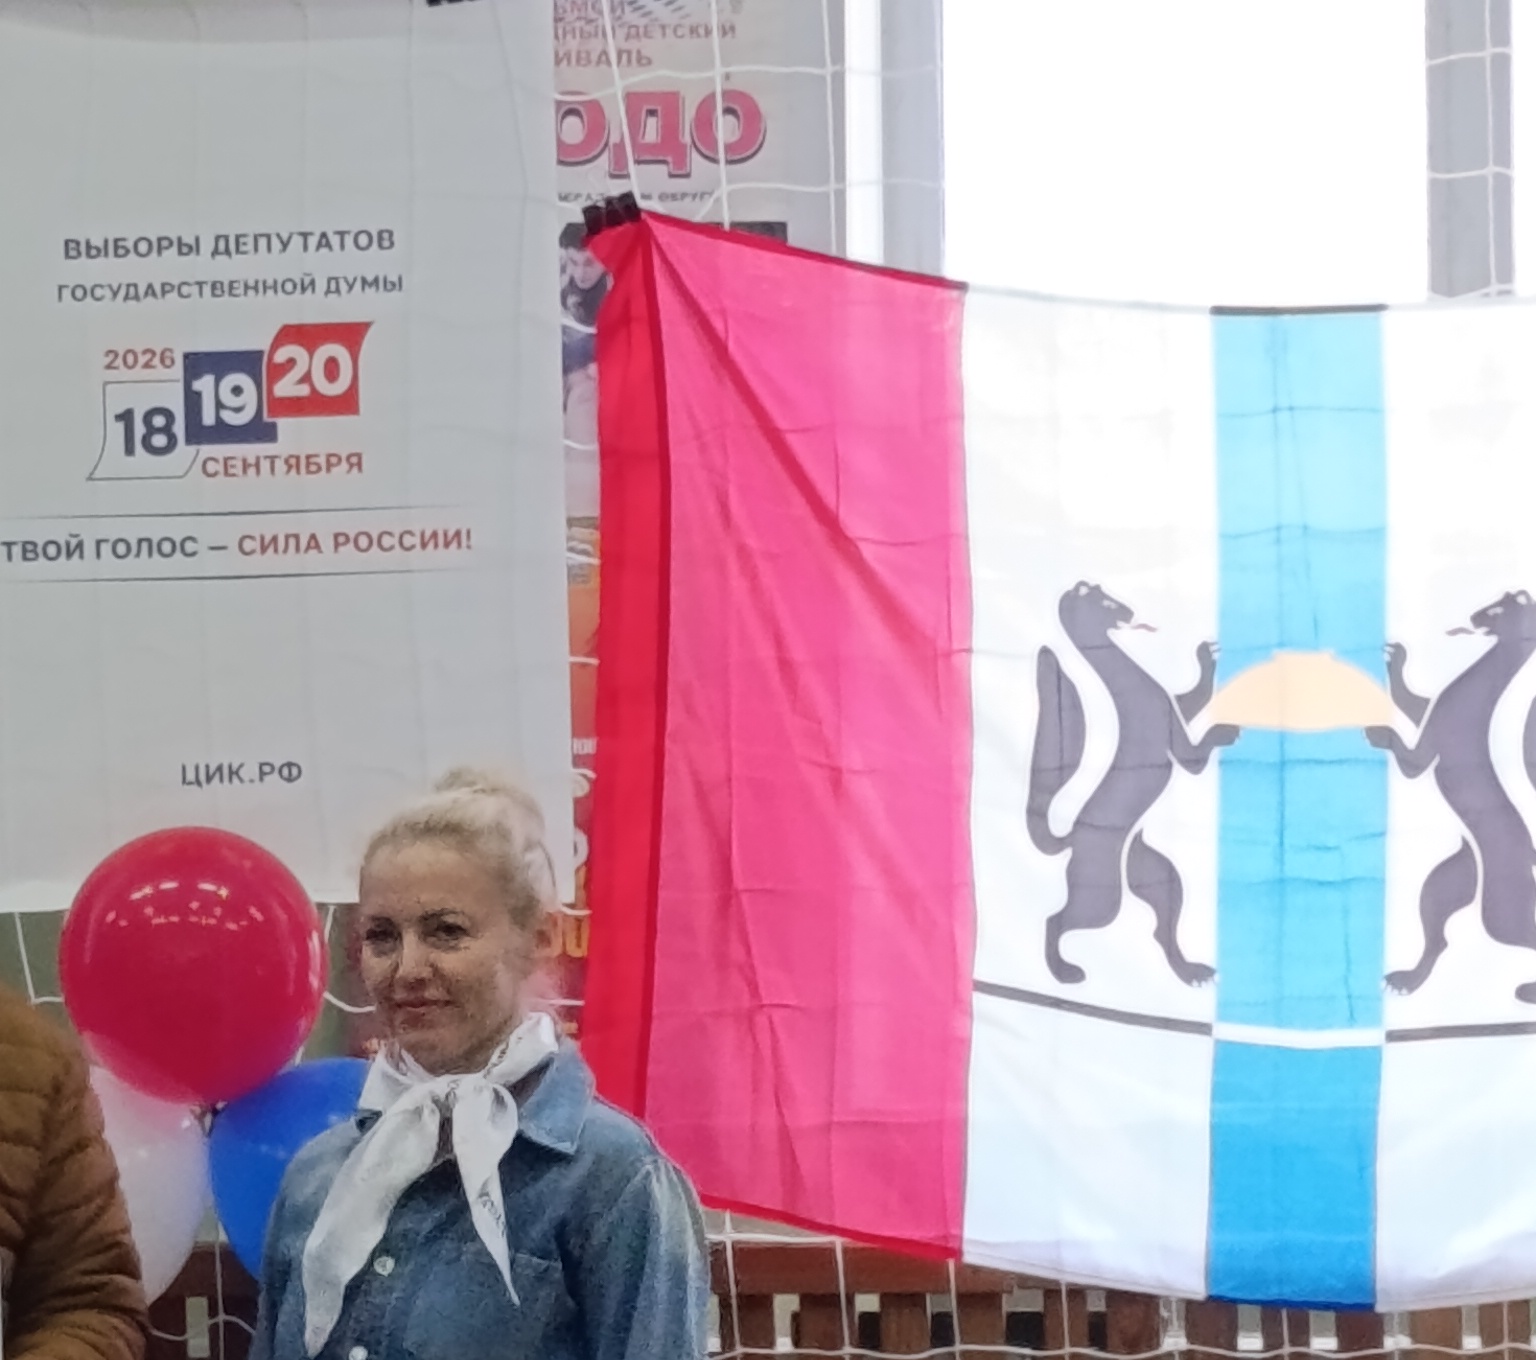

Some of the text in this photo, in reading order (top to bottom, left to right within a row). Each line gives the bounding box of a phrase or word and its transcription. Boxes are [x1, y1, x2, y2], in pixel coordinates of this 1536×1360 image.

[64, 229, 395, 260] ВЫБОРЫ ДЕПУТАТОВ
[57, 274, 403, 304] ГОСУДАРСТВЕННОЙ ДУМЫ
[104, 348, 176, 371] 2026
[272, 343, 353, 398] 20
[192, 373, 258, 427] 19
[114, 407, 178, 458] 18
[202, 453, 363, 478] СЕНТЯБРЯ
[1, 534, 85, 564] ТВОЙ
[95, 536, 198, 561] ГОЛОС
[238, 532, 323, 558] СИЛА
[334, 528, 473, 555] РОССИИ!
[180, 760, 303, 788] ЦИК.РФ
